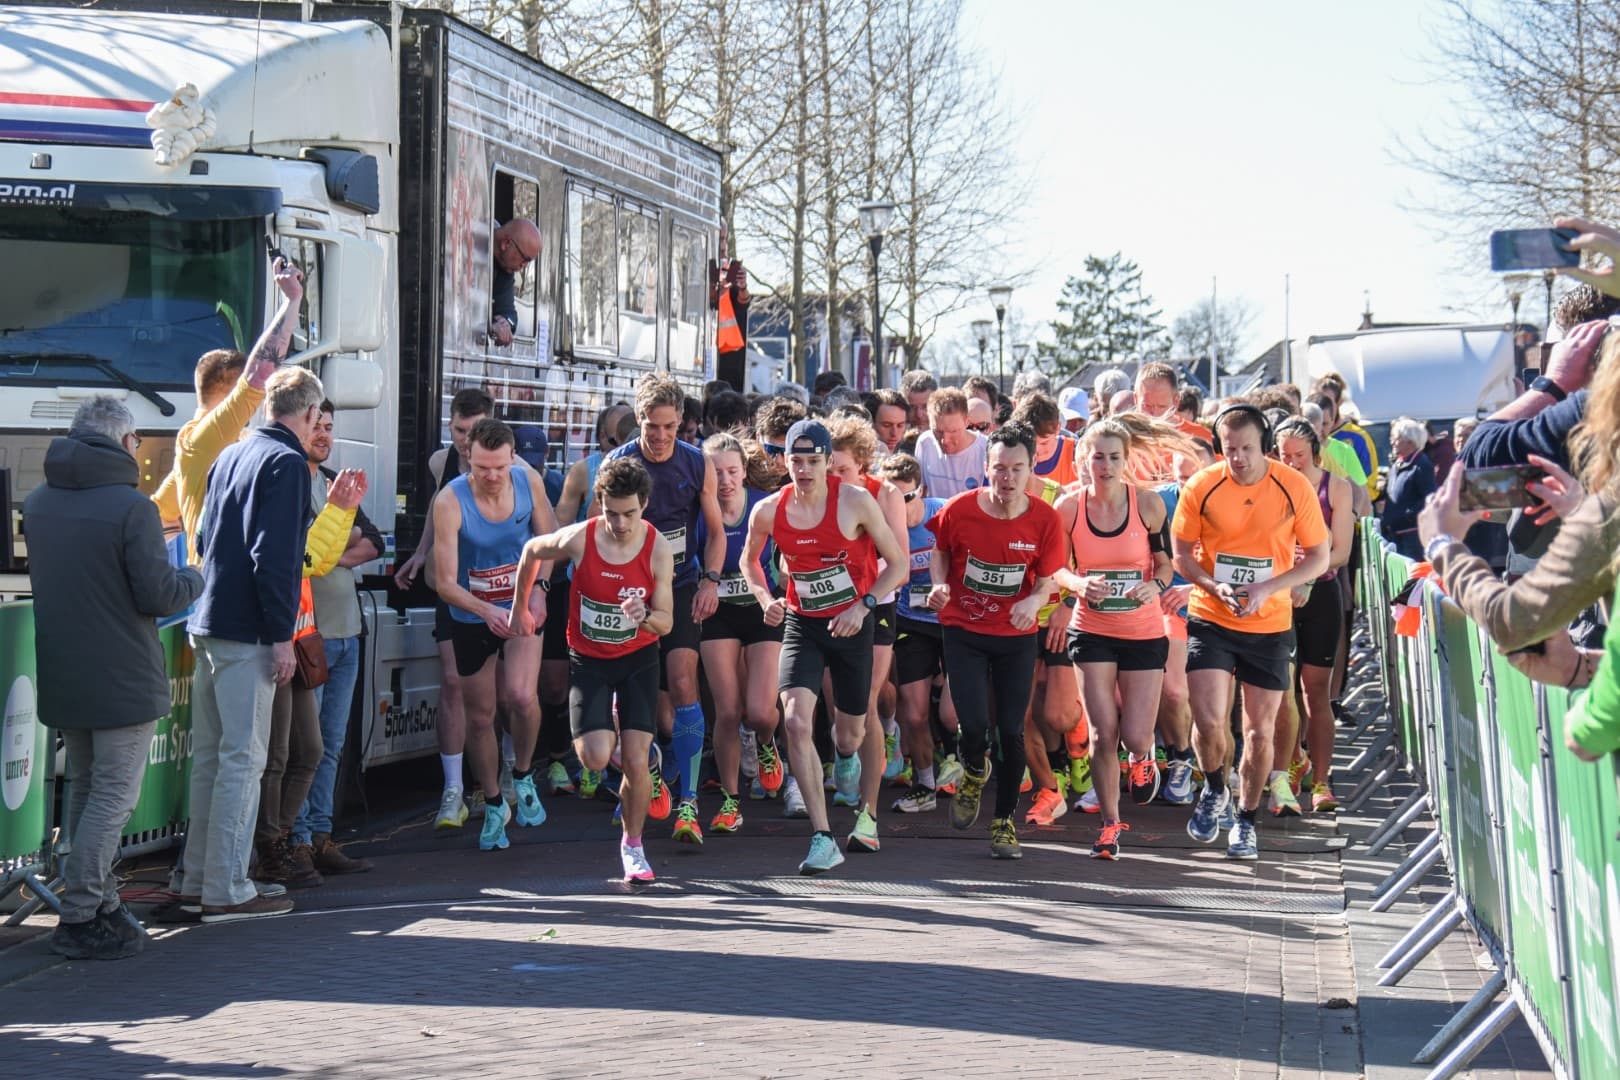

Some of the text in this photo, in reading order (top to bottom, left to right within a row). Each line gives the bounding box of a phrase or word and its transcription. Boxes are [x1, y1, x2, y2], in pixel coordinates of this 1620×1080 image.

[915, 551, 931, 564] GV
[488, 575, 511, 589] 192
[982, 571, 1005, 585] 351
[1231, 567, 1255, 583] 473
[727, 580, 749, 594] 378
[809, 580, 835, 595] 408
[1105, 582, 1126, 597] 67
[594, 613, 621, 630] 482
[149, 722, 194, 771] an Spo
